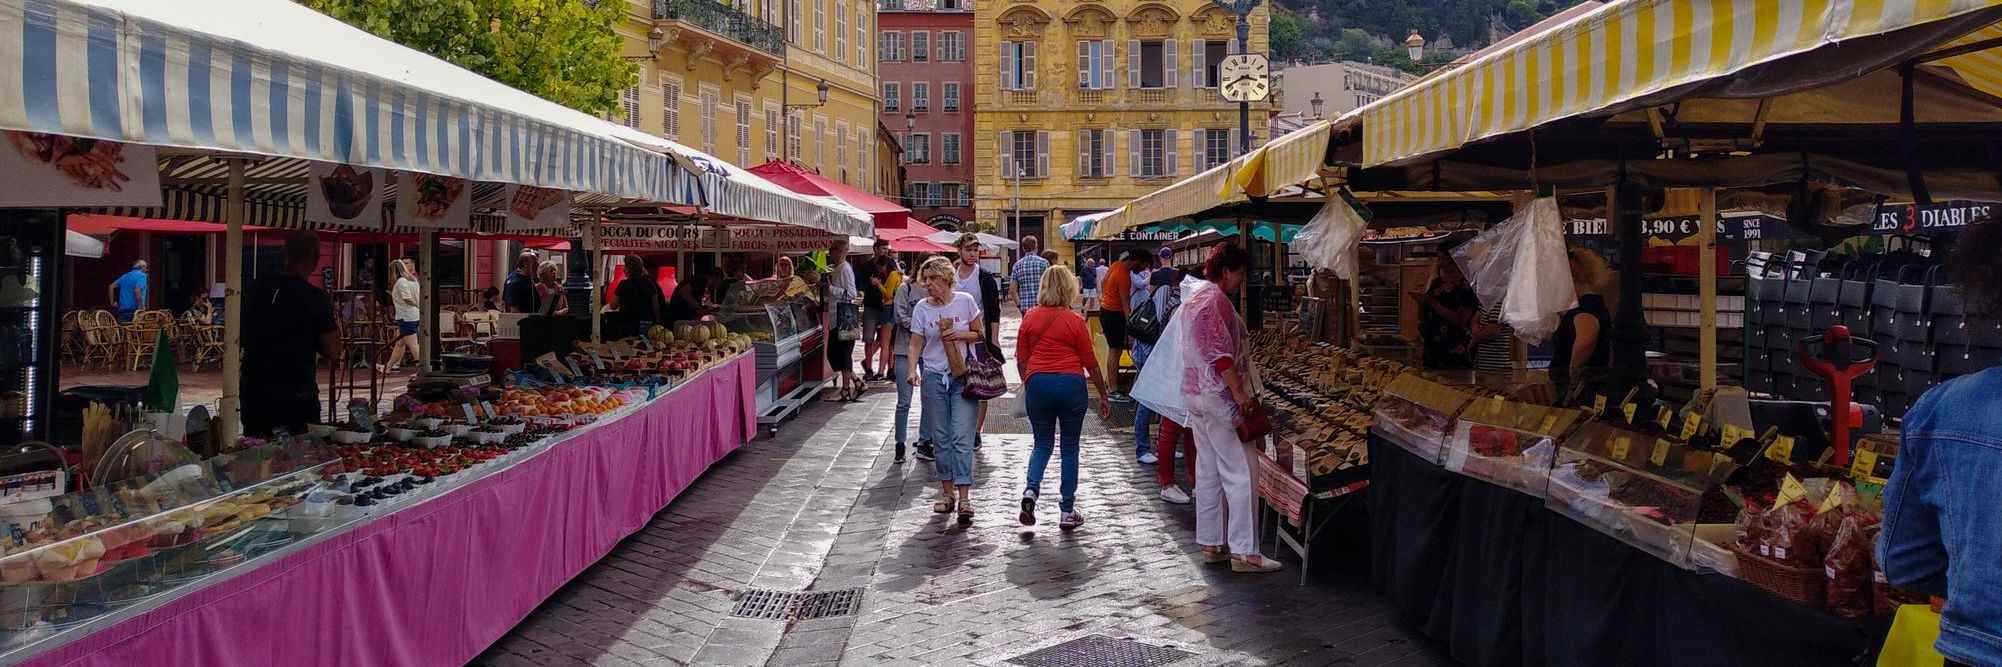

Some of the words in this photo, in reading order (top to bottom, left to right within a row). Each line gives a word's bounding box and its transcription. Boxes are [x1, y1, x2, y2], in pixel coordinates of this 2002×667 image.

[1743, 219, 1760, 229] SINCE
[1903, 205, 1915, 233] 3
[600, 225, 632, 238] OCCA
[636, 226, 653, 238] DU
[1680, 219, 1691, 234] €
[1130, 231, 1179, 241] CONTAINER
[1743, 228, 1760, 239] 1991
